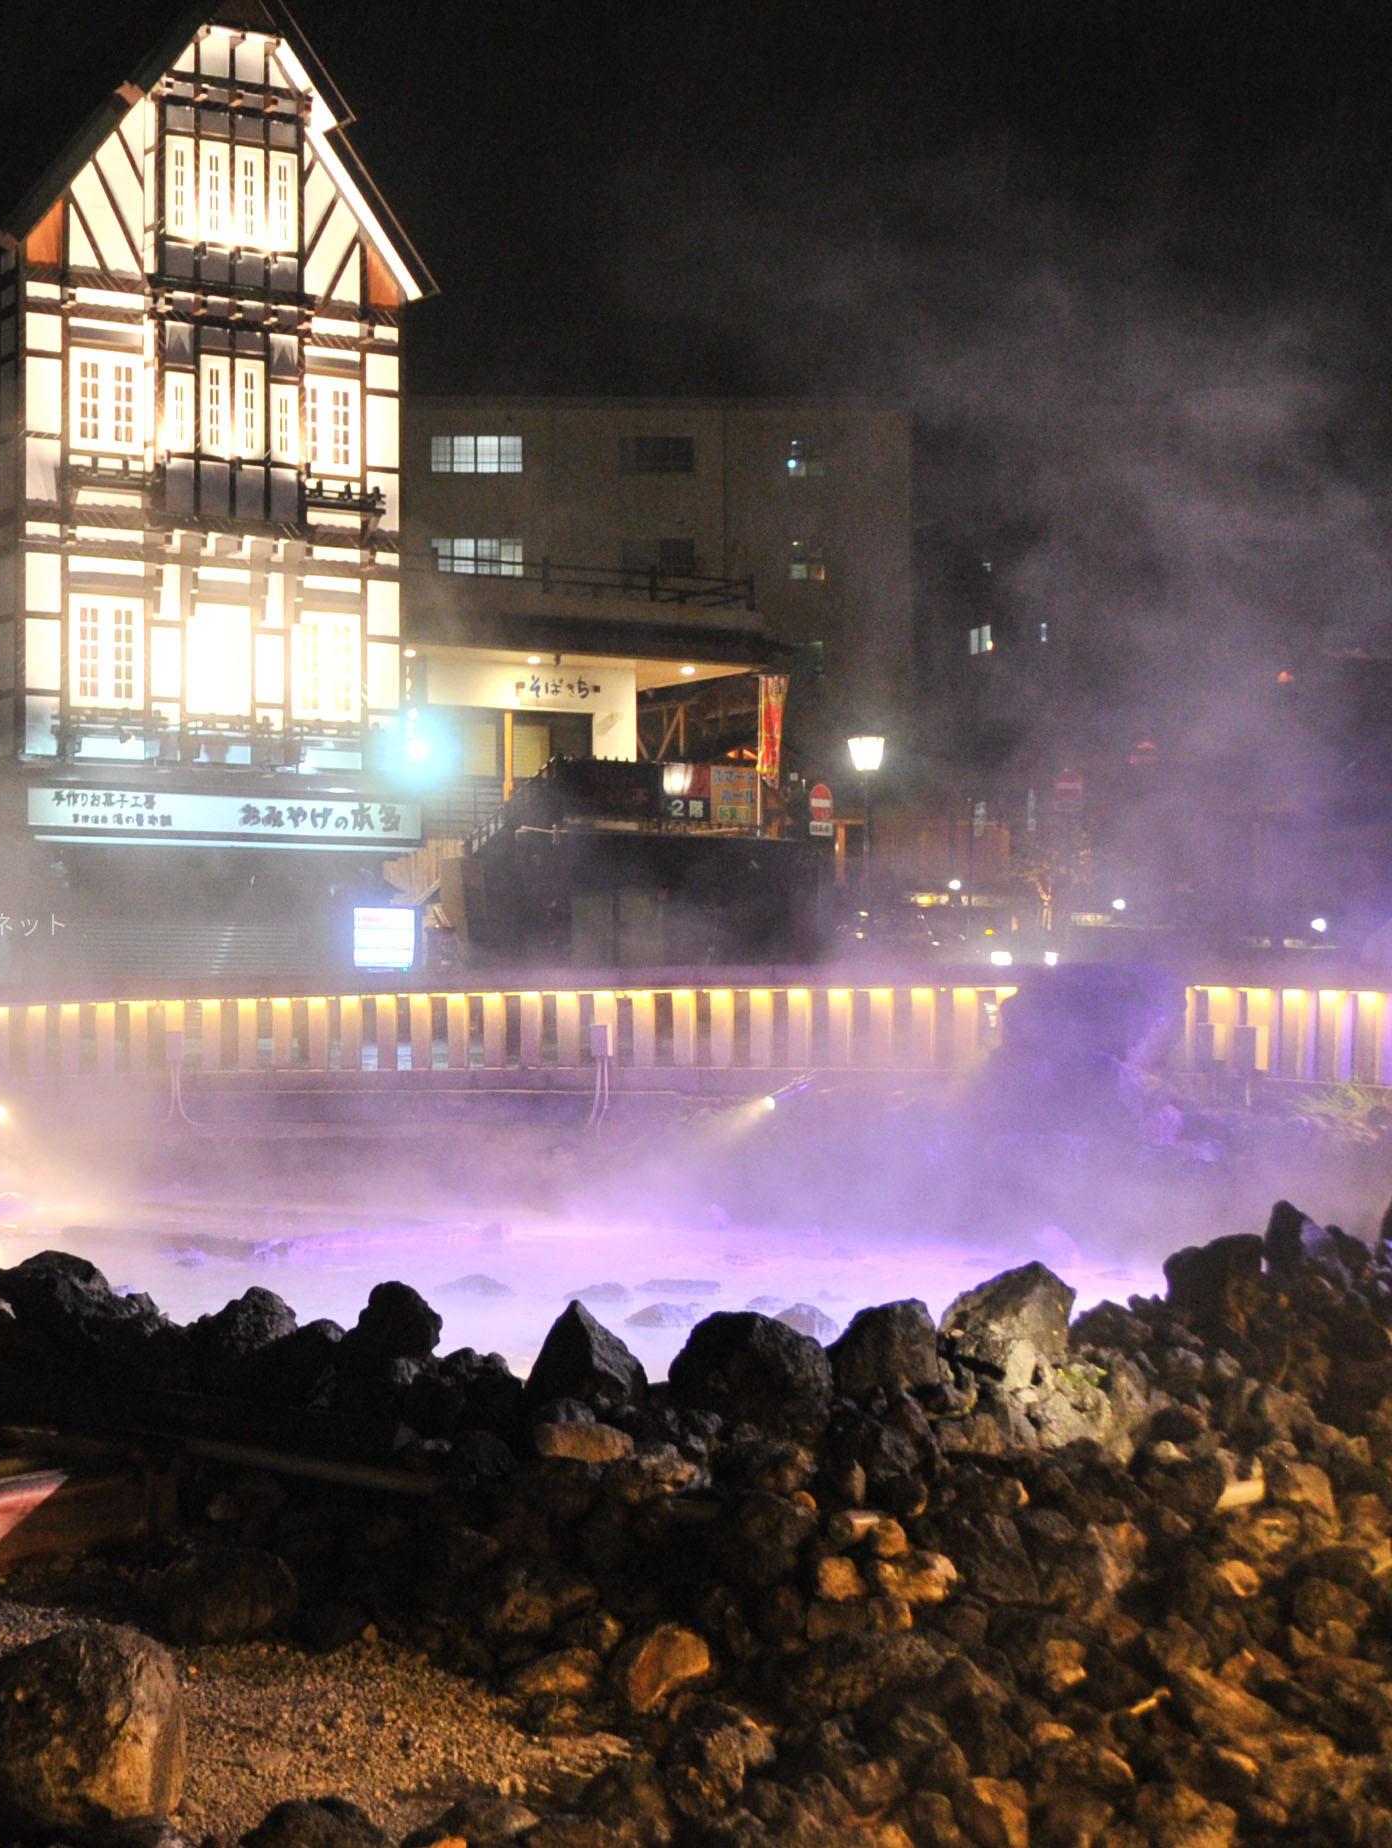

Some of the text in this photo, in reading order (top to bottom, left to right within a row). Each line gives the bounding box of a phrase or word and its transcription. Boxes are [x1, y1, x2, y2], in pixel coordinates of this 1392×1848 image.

[529, 674, 590, 699] そばきち
[671, 799, 704, 819] 2階
